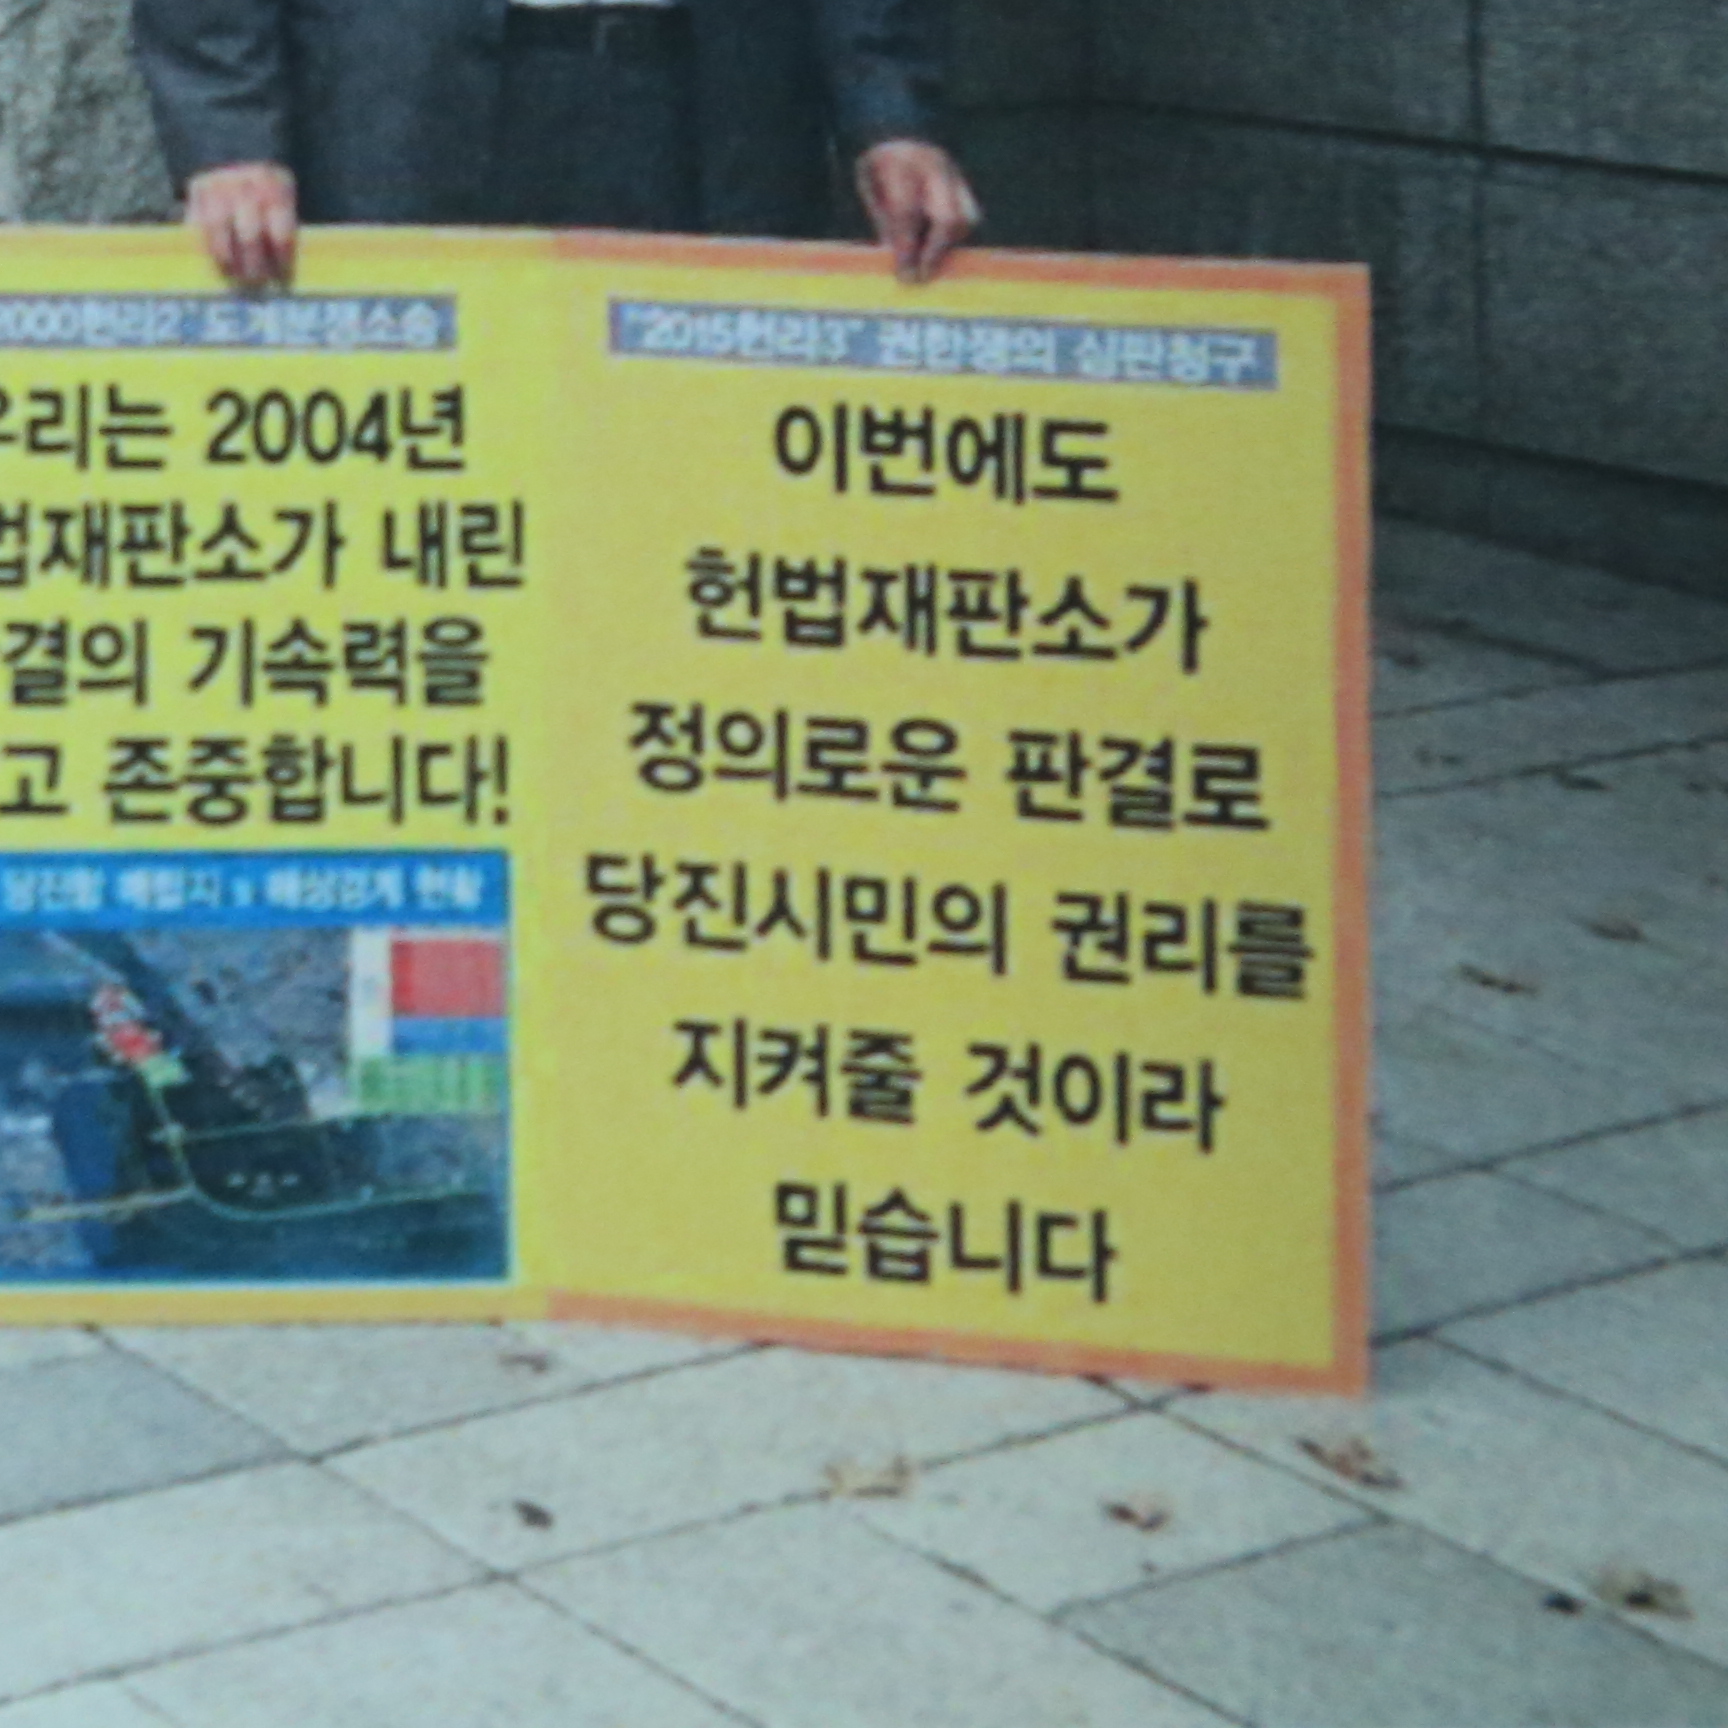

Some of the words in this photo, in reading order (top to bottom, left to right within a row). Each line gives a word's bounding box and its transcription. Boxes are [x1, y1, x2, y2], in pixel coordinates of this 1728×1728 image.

[206, 386, 464, 471] 2004년
[774, 404, 1118, 505] 이번에도
[382, 501, 523, 588] 내린
[190, 617, 487, 707] 기속력을
[688, 548, 1208, 674] 헌법재판소가
[103, 735, 508, 827] 존중합니다!
[630, 702, 966, 813] 정의로운
[1007, 731, 1269, 831] 판결로
[586, 854, 1007, 976] 당진시민의
[1052, 893, 1313, 1000] 권리를
[674, 1019, 920, 1124] 지켜줄
[967, 1044, 1225, 1154] 것이라
[775, 1182, 1116, 1304] 믿습니다
